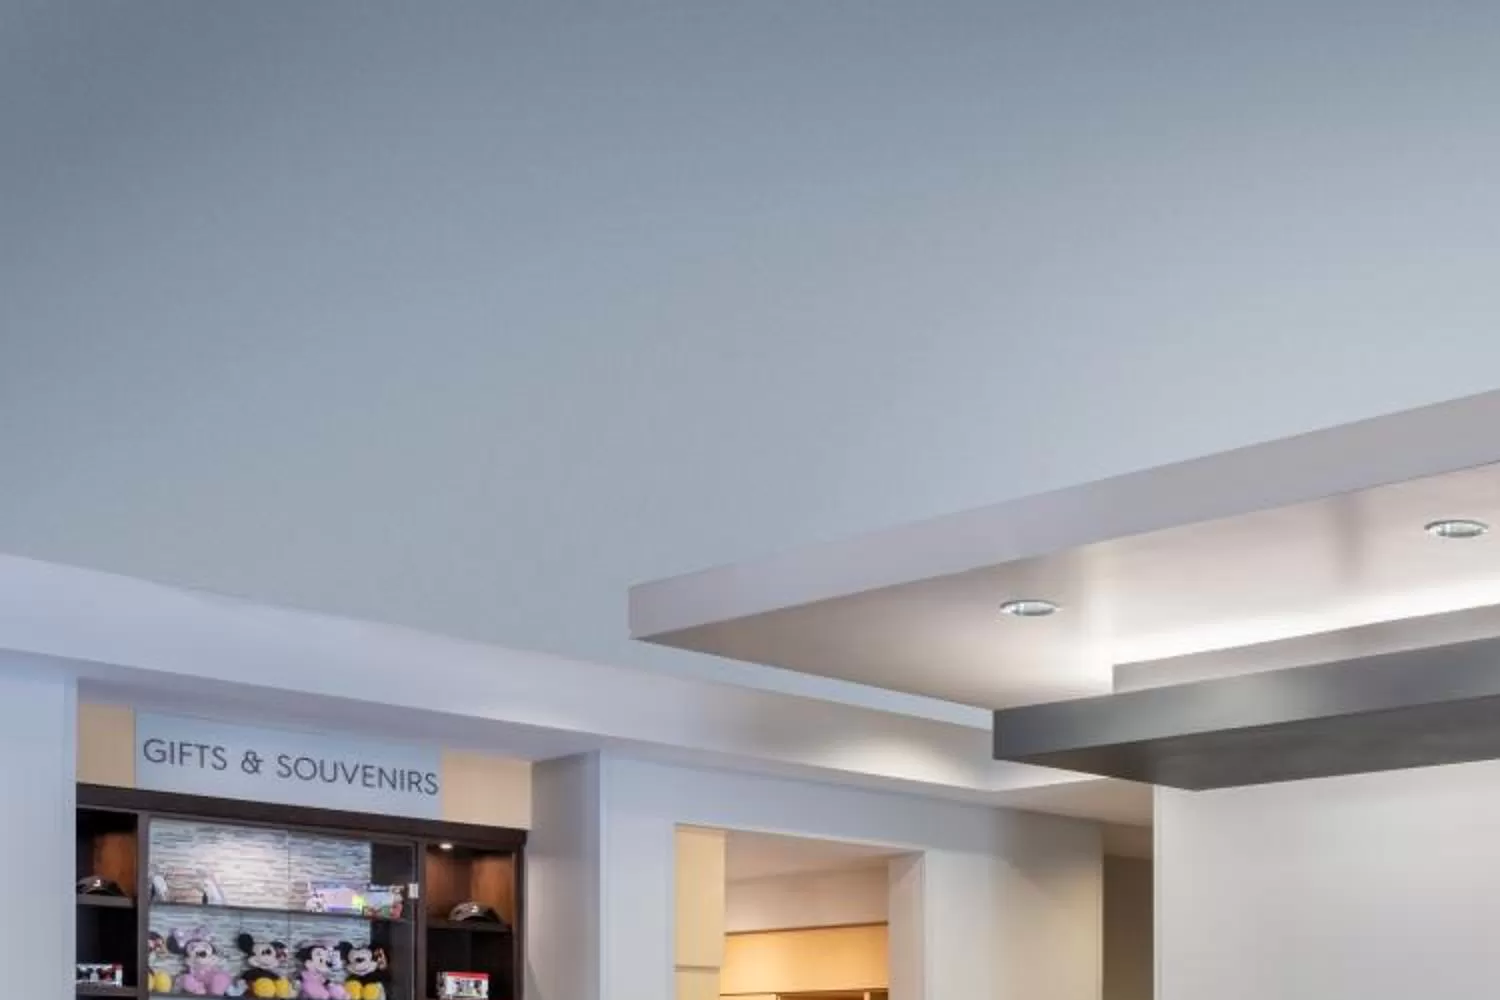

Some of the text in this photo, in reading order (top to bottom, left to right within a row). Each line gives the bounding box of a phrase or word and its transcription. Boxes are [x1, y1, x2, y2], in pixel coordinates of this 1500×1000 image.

[143, 738, 440, 796] GIFTS & SOUVENIRS
